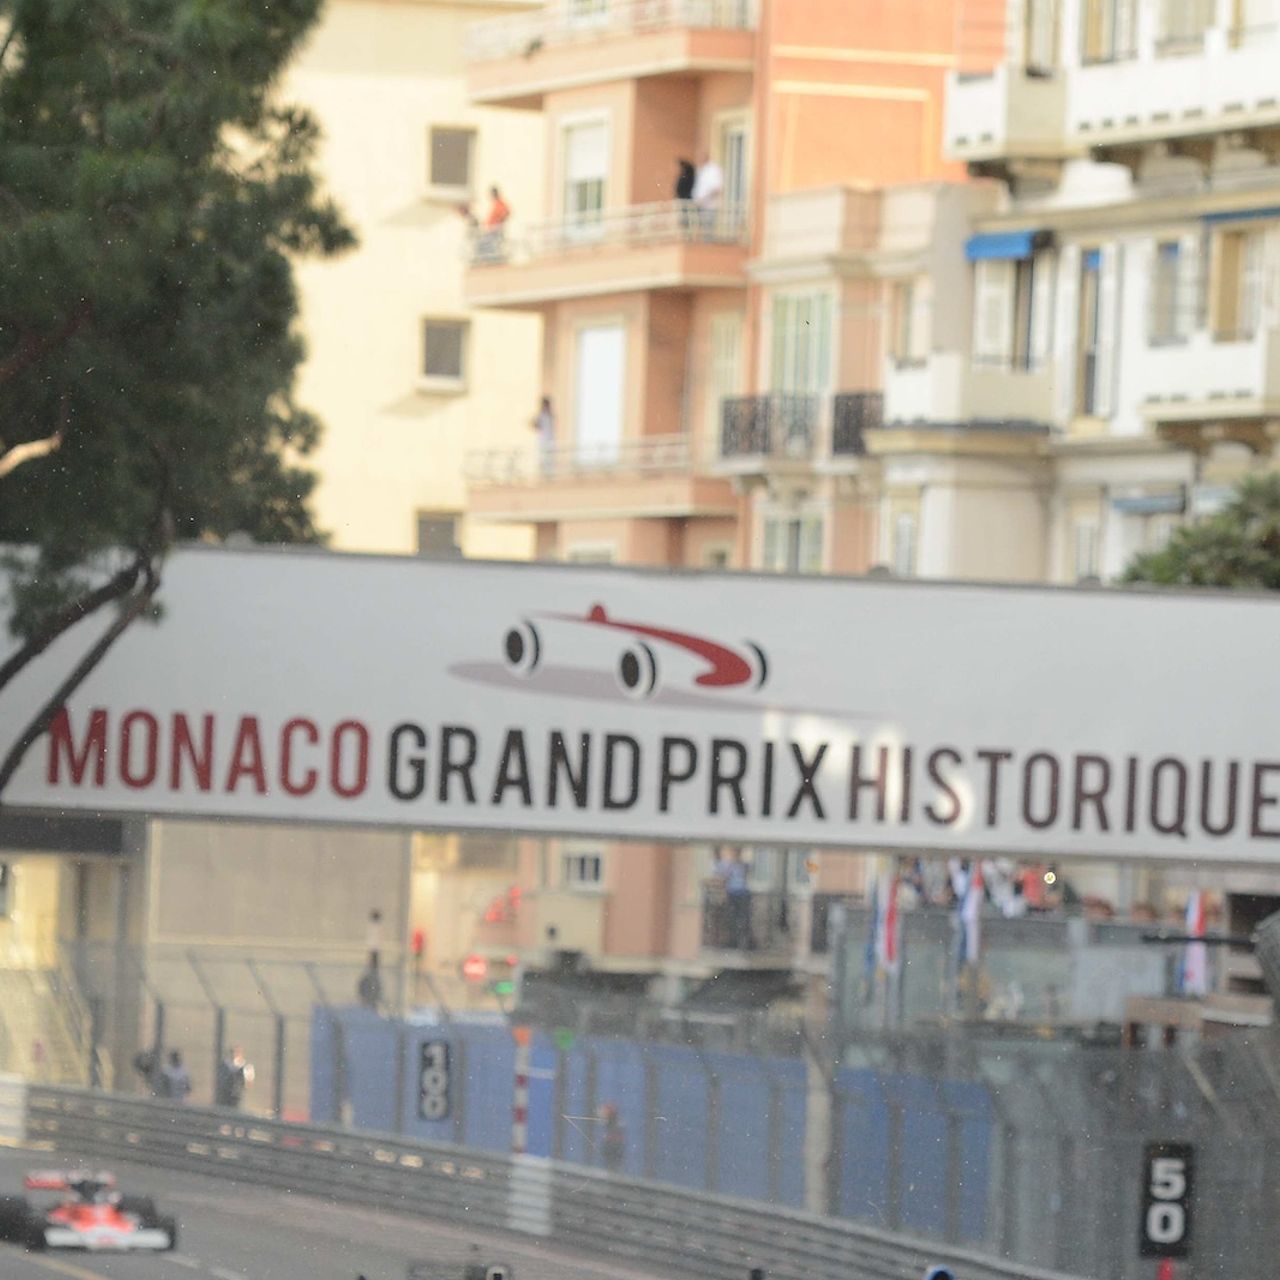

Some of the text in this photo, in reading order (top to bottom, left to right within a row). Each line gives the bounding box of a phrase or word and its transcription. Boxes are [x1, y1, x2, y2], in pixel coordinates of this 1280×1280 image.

[47, 705, 370, 798] MONACO
[387, 721, 641, 811] GRAND
[660, 733, 829, 821] PRIX
[1146, 1156, 1187, 1245] 50
